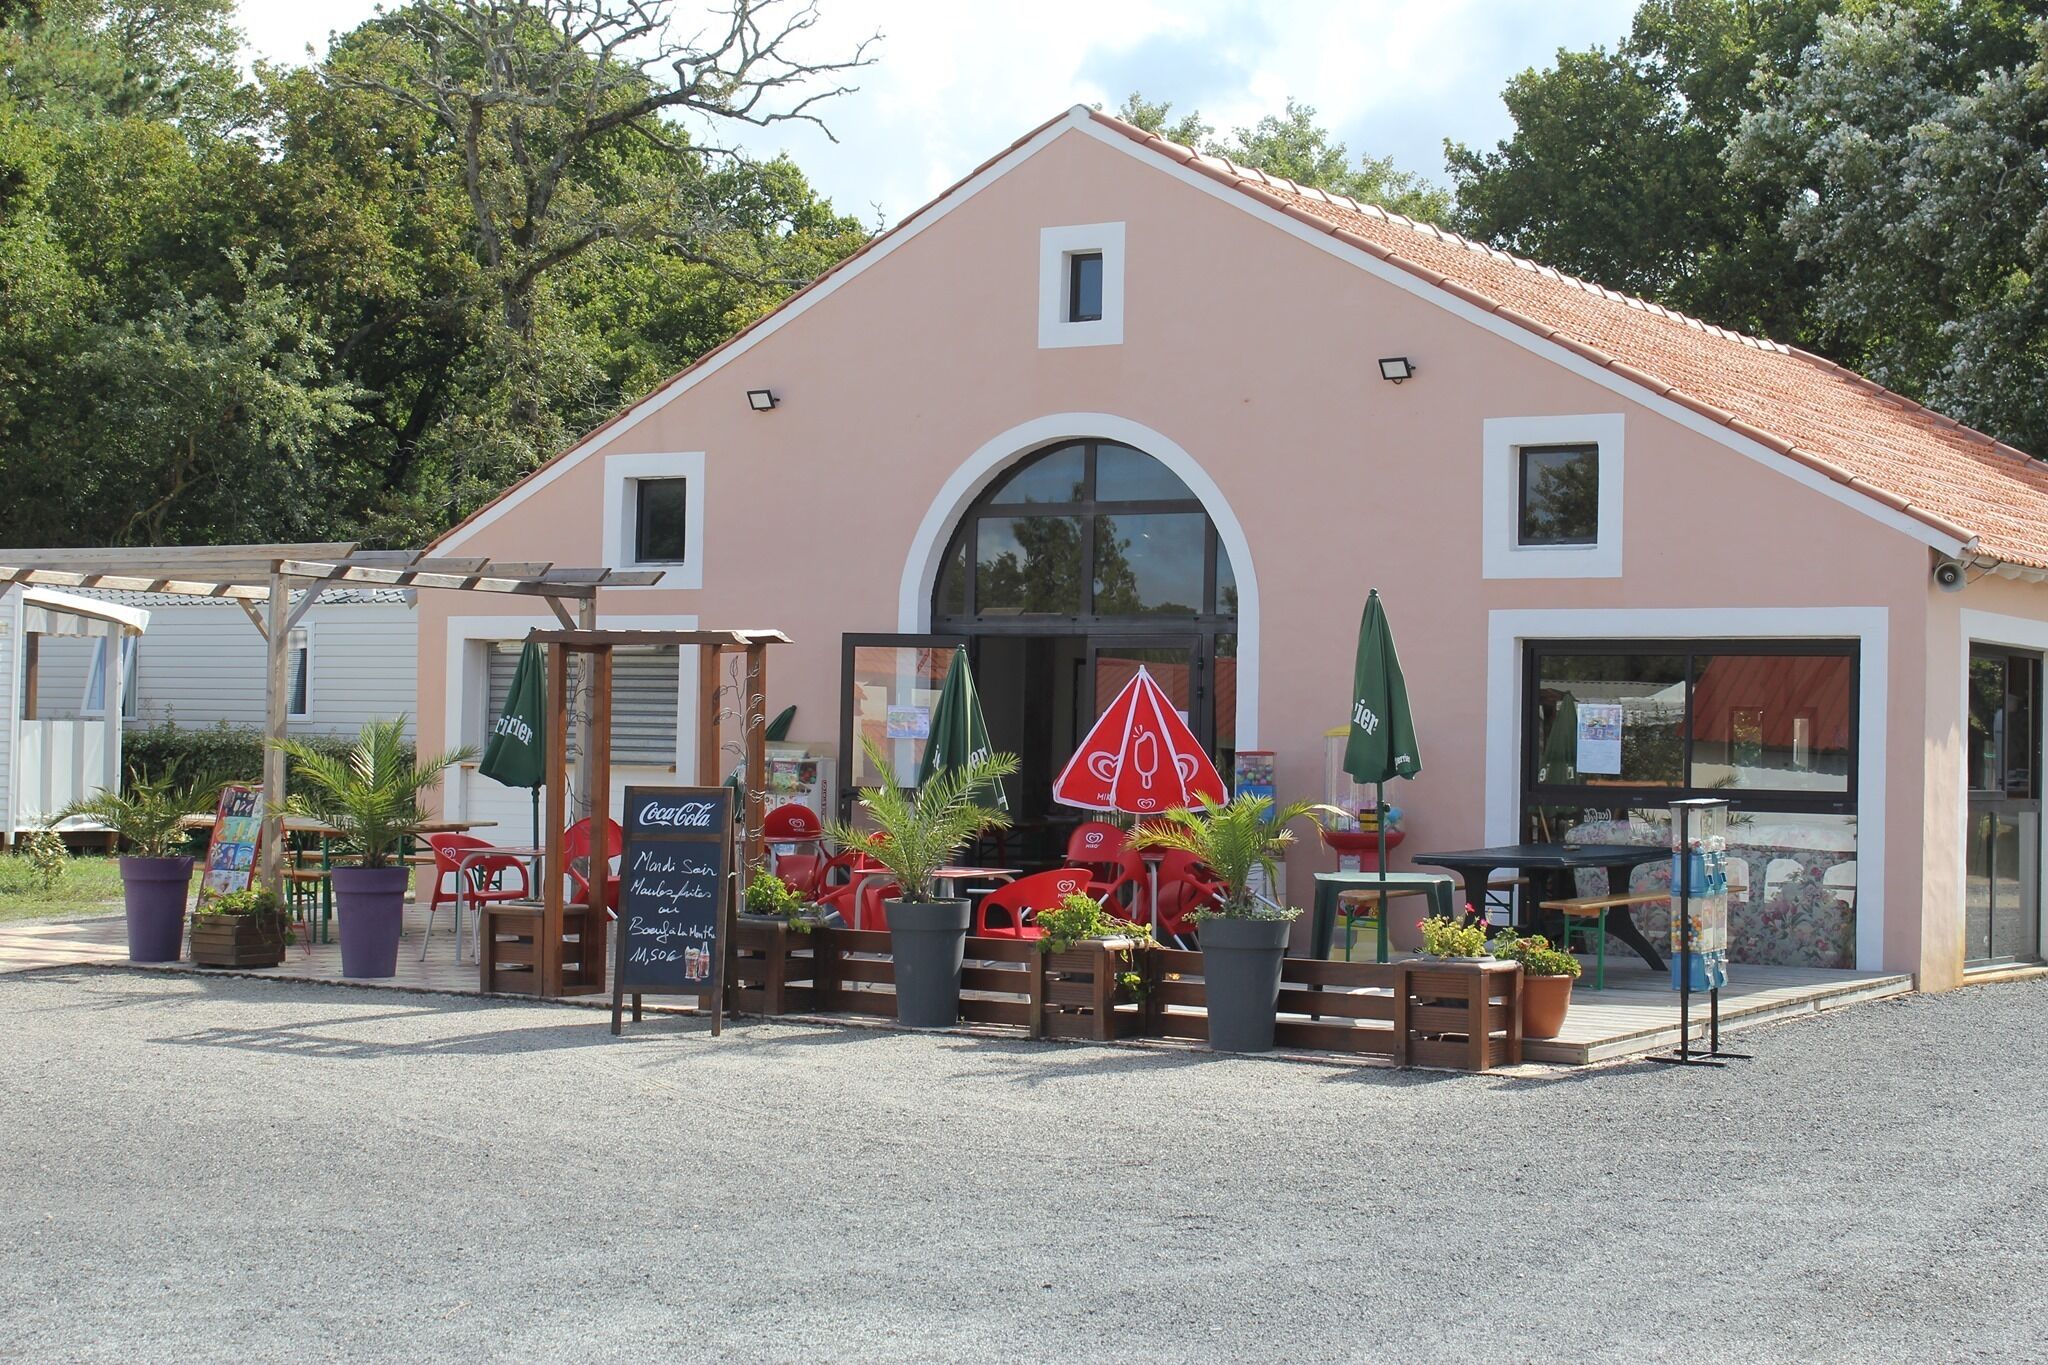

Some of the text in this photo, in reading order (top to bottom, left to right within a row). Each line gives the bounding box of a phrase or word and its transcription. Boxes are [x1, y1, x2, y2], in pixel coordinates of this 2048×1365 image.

[1096, 792, 1112, 801] MIK
[638, 801, 716, 827] Coca-Cola
[633, 850, 717, 877] Mardi Soir
[658, 906, 680, 914] ou
